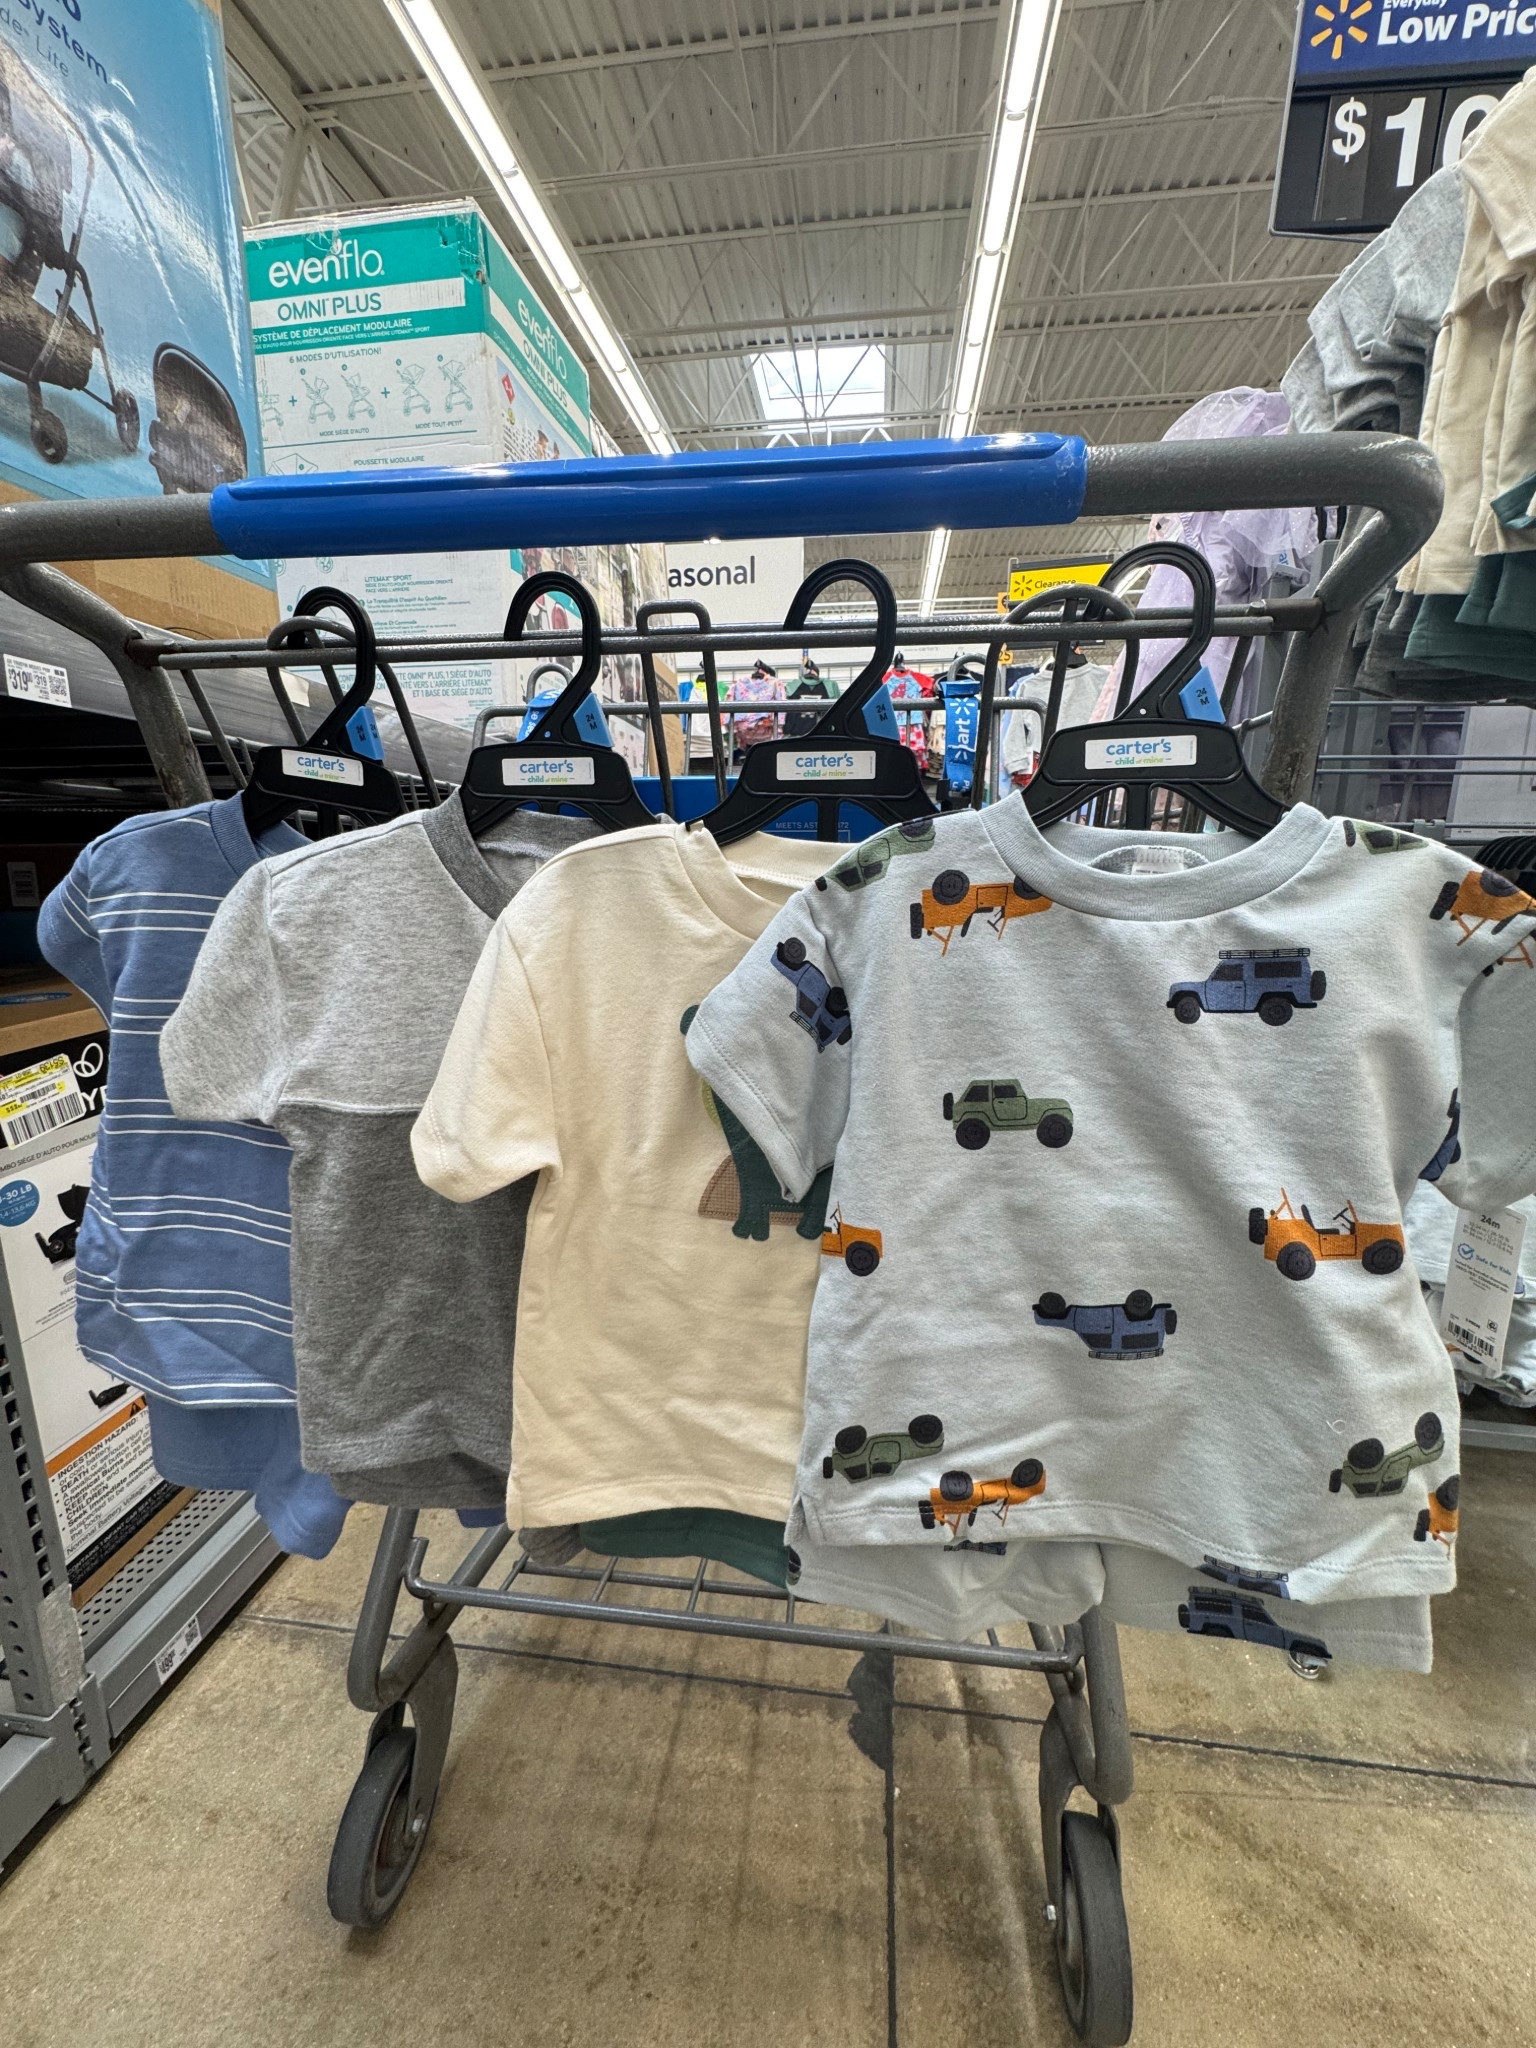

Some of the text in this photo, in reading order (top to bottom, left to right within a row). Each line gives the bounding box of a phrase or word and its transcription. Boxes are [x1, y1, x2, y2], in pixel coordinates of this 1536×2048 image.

[1377, 0, 1536, 45] Low Pric
[36, 35, 68, 77] Lite
[268, 239, 383, 288] evenflo
[332, 292, 382, 316] PLUS
[254, 329, 289, 344] SYSTÈME
[290, 330, 302, 339] DE
[303, 322, 362, 337] DÉPLACEMENT
[364, 318, 412, 331] MODULAIRE
[296, 353, 323, 362] MODES
[547, 373, 568, 408] PLUS
[390, 455, 424, 464] MODULAIRE
[668, 555, 755, 587] asonal
[451, 669, 467, 678] SIÈGE
[469, 669, 491, 678] D'AUTO
[413, 680, 429, 689] VERS
[413, 690, 420, 698] ET
[425, 689, 441, 697] BASE
[451, 688, 468, 696] SIÈGE
[469, 688, 492, 696] D'AUTO
[1195, 687, 1207, 698] 24
[876, 703, 886, 713] 24
[586, 713, 595, 722] 24
[879, 713, 888, 721] M
[589, 722, 598, 730] M
[1106, 738, 1172, 755] carter's
[297, 756, 345, 772] carter's
[519, 760, 574, 773] carter's
[795, 753, 854, 768] carter's
[1114, 757, 1135, 766] child
[304, 769, 319, 777] child
[527, 775, 545, 783] child
[775, 821, 802, 829] MEETS
[36, 1146, 61, 1158] D'AUTO
[21, 1184, 32, 1195] LB
[1480, 1214, 1500, 1229] 24m
[57, 1441, 103, 1479] INGESTION
[104, 1416, 137, 1444] HAZARD:
[59, 1478, 64, 1486] or
[66, 1463, 84, 1480] coin
[60, 1467, 88, 1492] DEATH
[90, 1461, 98, 1470] or
[63, 1475, 100, 1506] Chemical
[101, 1457, 123, 1477] Burns
[65, 1491, 88, 1513] KEEP
[66, 1483, 109, 1520] CHILDREN
[68, 1508, 87, 1527] Seek
[88, 1475, 127, 1510] immediate
[66, 1525, 96, 1555] Nominal
[97, 1504, 121, 1528] Battery
